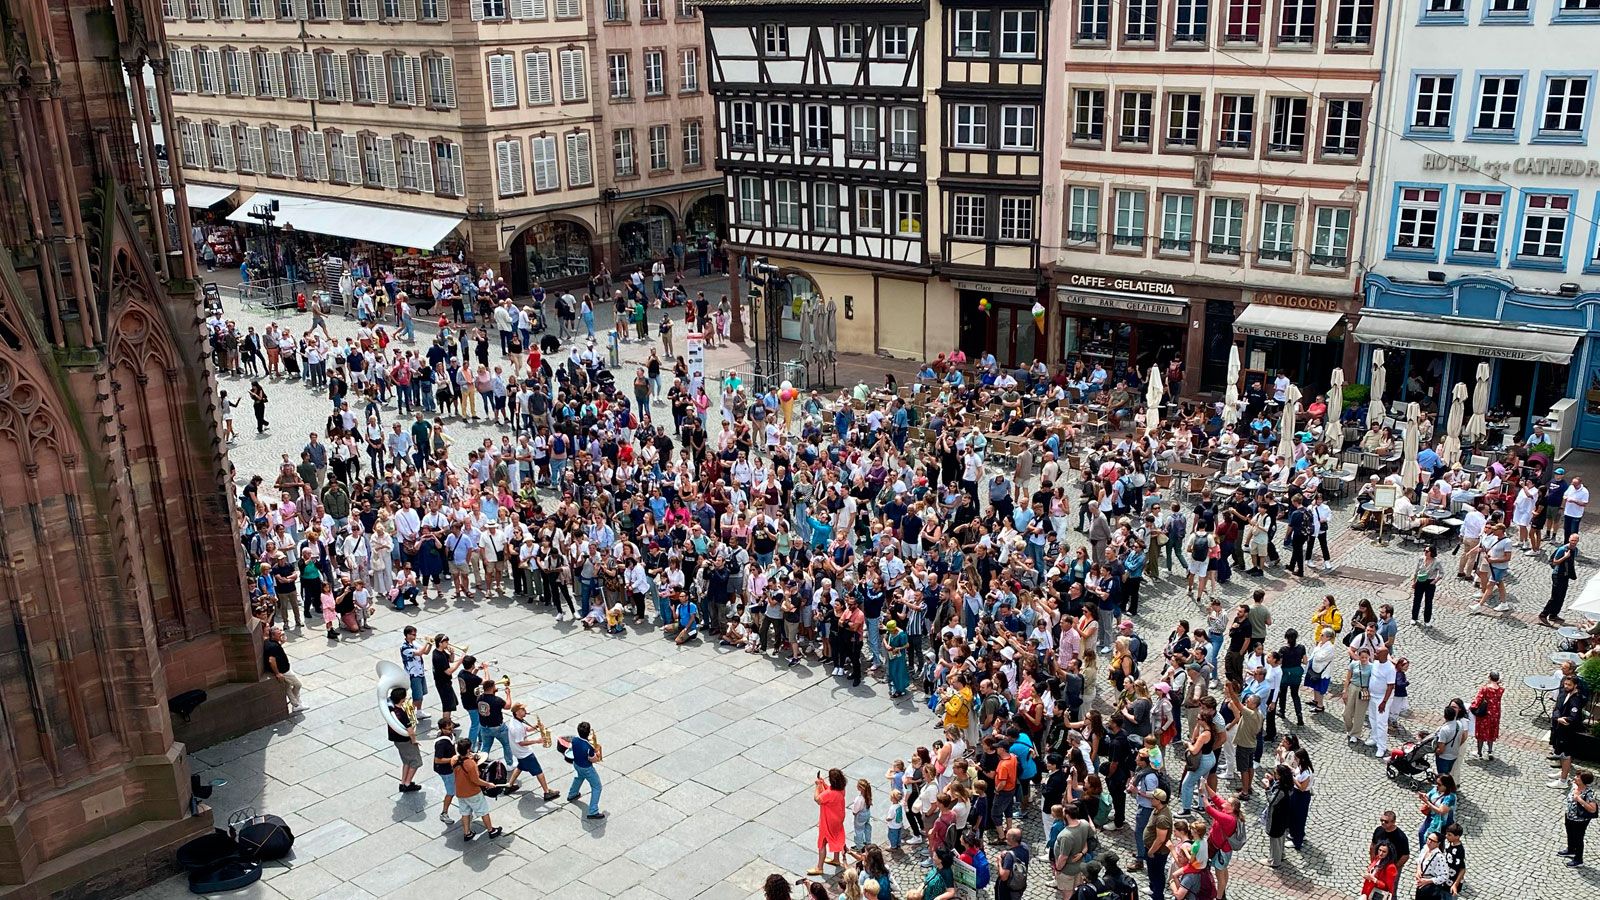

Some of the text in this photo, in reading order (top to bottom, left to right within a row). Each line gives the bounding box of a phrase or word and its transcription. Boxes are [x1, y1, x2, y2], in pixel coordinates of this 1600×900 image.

[1423, 153, 1481, 173] HOTEL
[1071, 275, 1105, 287] CAFFE
[1114, 279, 1175, 294] GELATERIA
[1100, 299, 1114, 307] BAR
[1126, 302, 1170, 314] GELATERIA
[1252, 292, 1337, 311] LA CIGOGNE
[1264, 329, 1299, 340] CREPES
[1303, 334, 1322, 343] BAR
[1478, 347, 1527, 359] BRASSERIE
